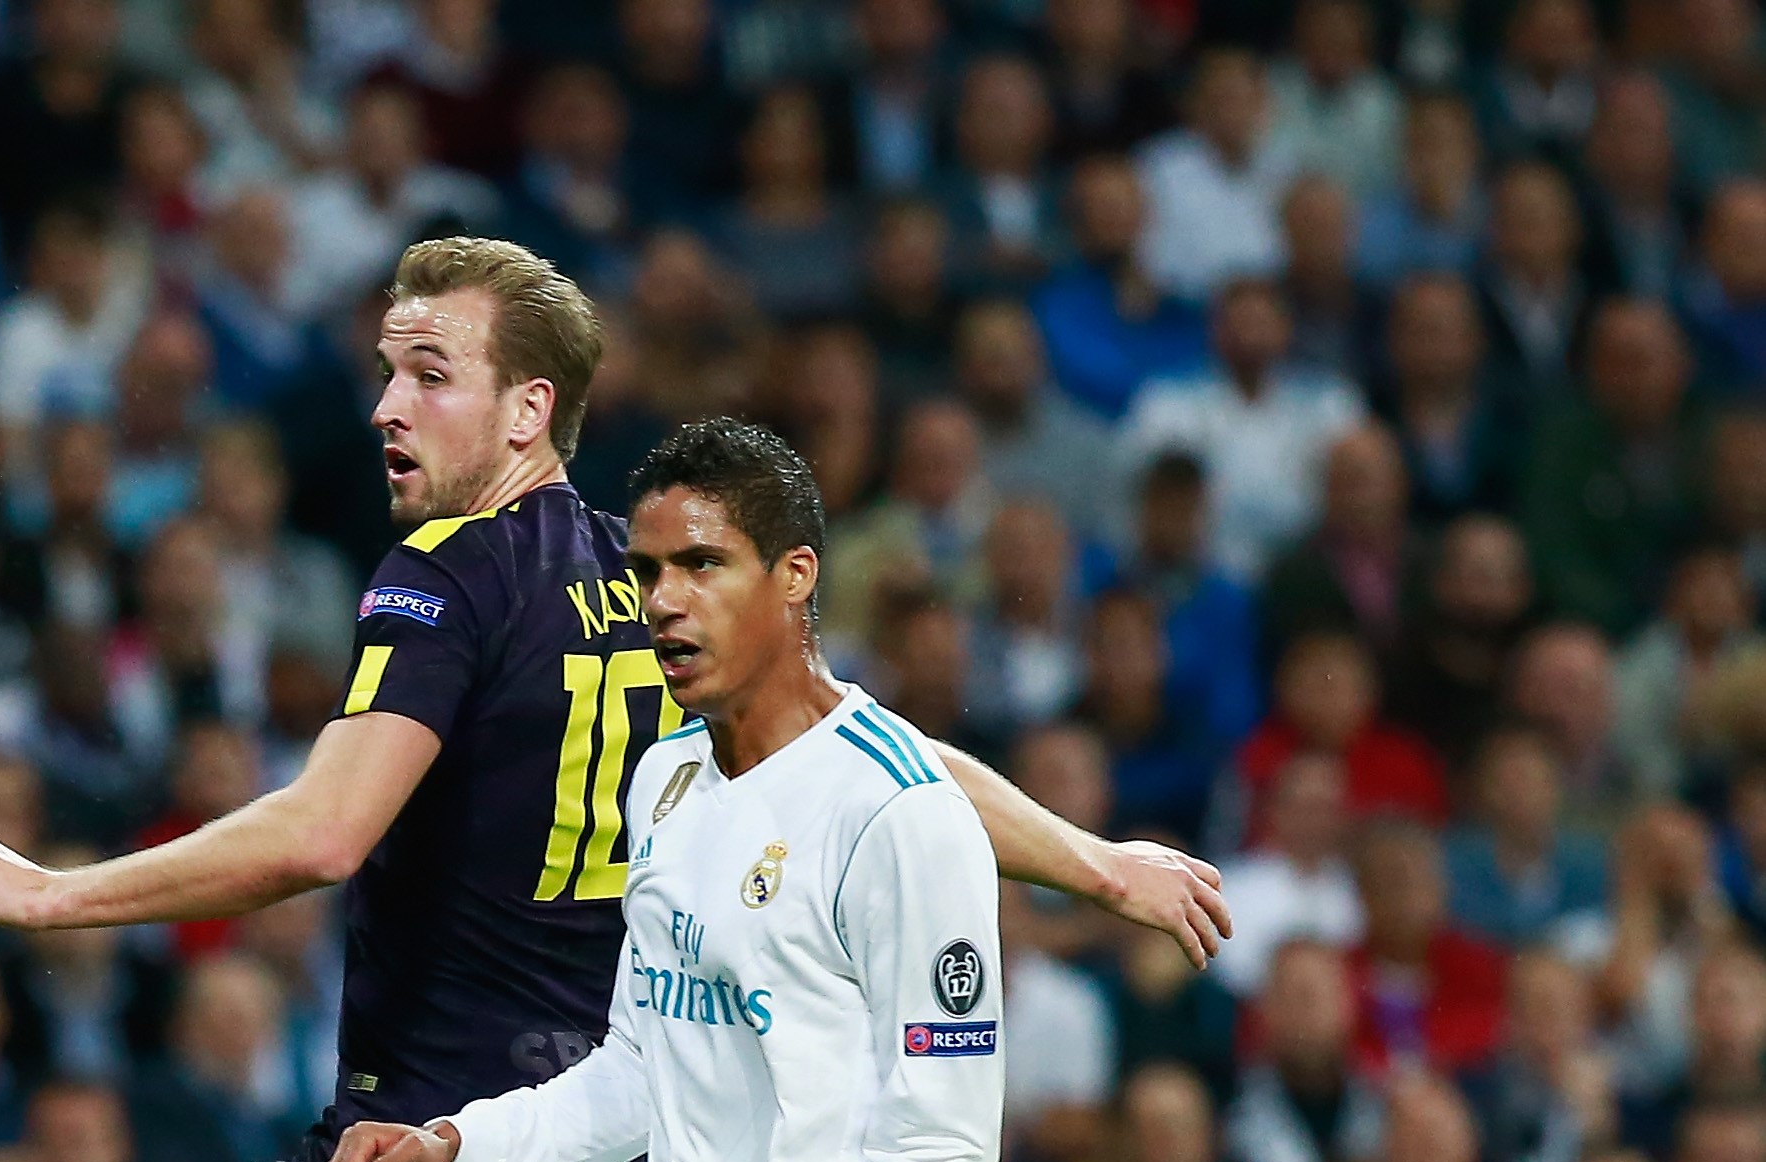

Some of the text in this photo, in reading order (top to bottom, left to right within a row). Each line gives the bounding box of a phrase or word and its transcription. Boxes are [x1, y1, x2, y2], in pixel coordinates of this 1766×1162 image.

[374, 592, 445, 619] RESPECT
[533, 648, 684, 901] 10
[672, 909, 706, 965] Fly
[630, 946, 775, 1037] Emirates
[950, 976, 971, 996] 12
[933, 1030, 997, 1048] RESPECT
